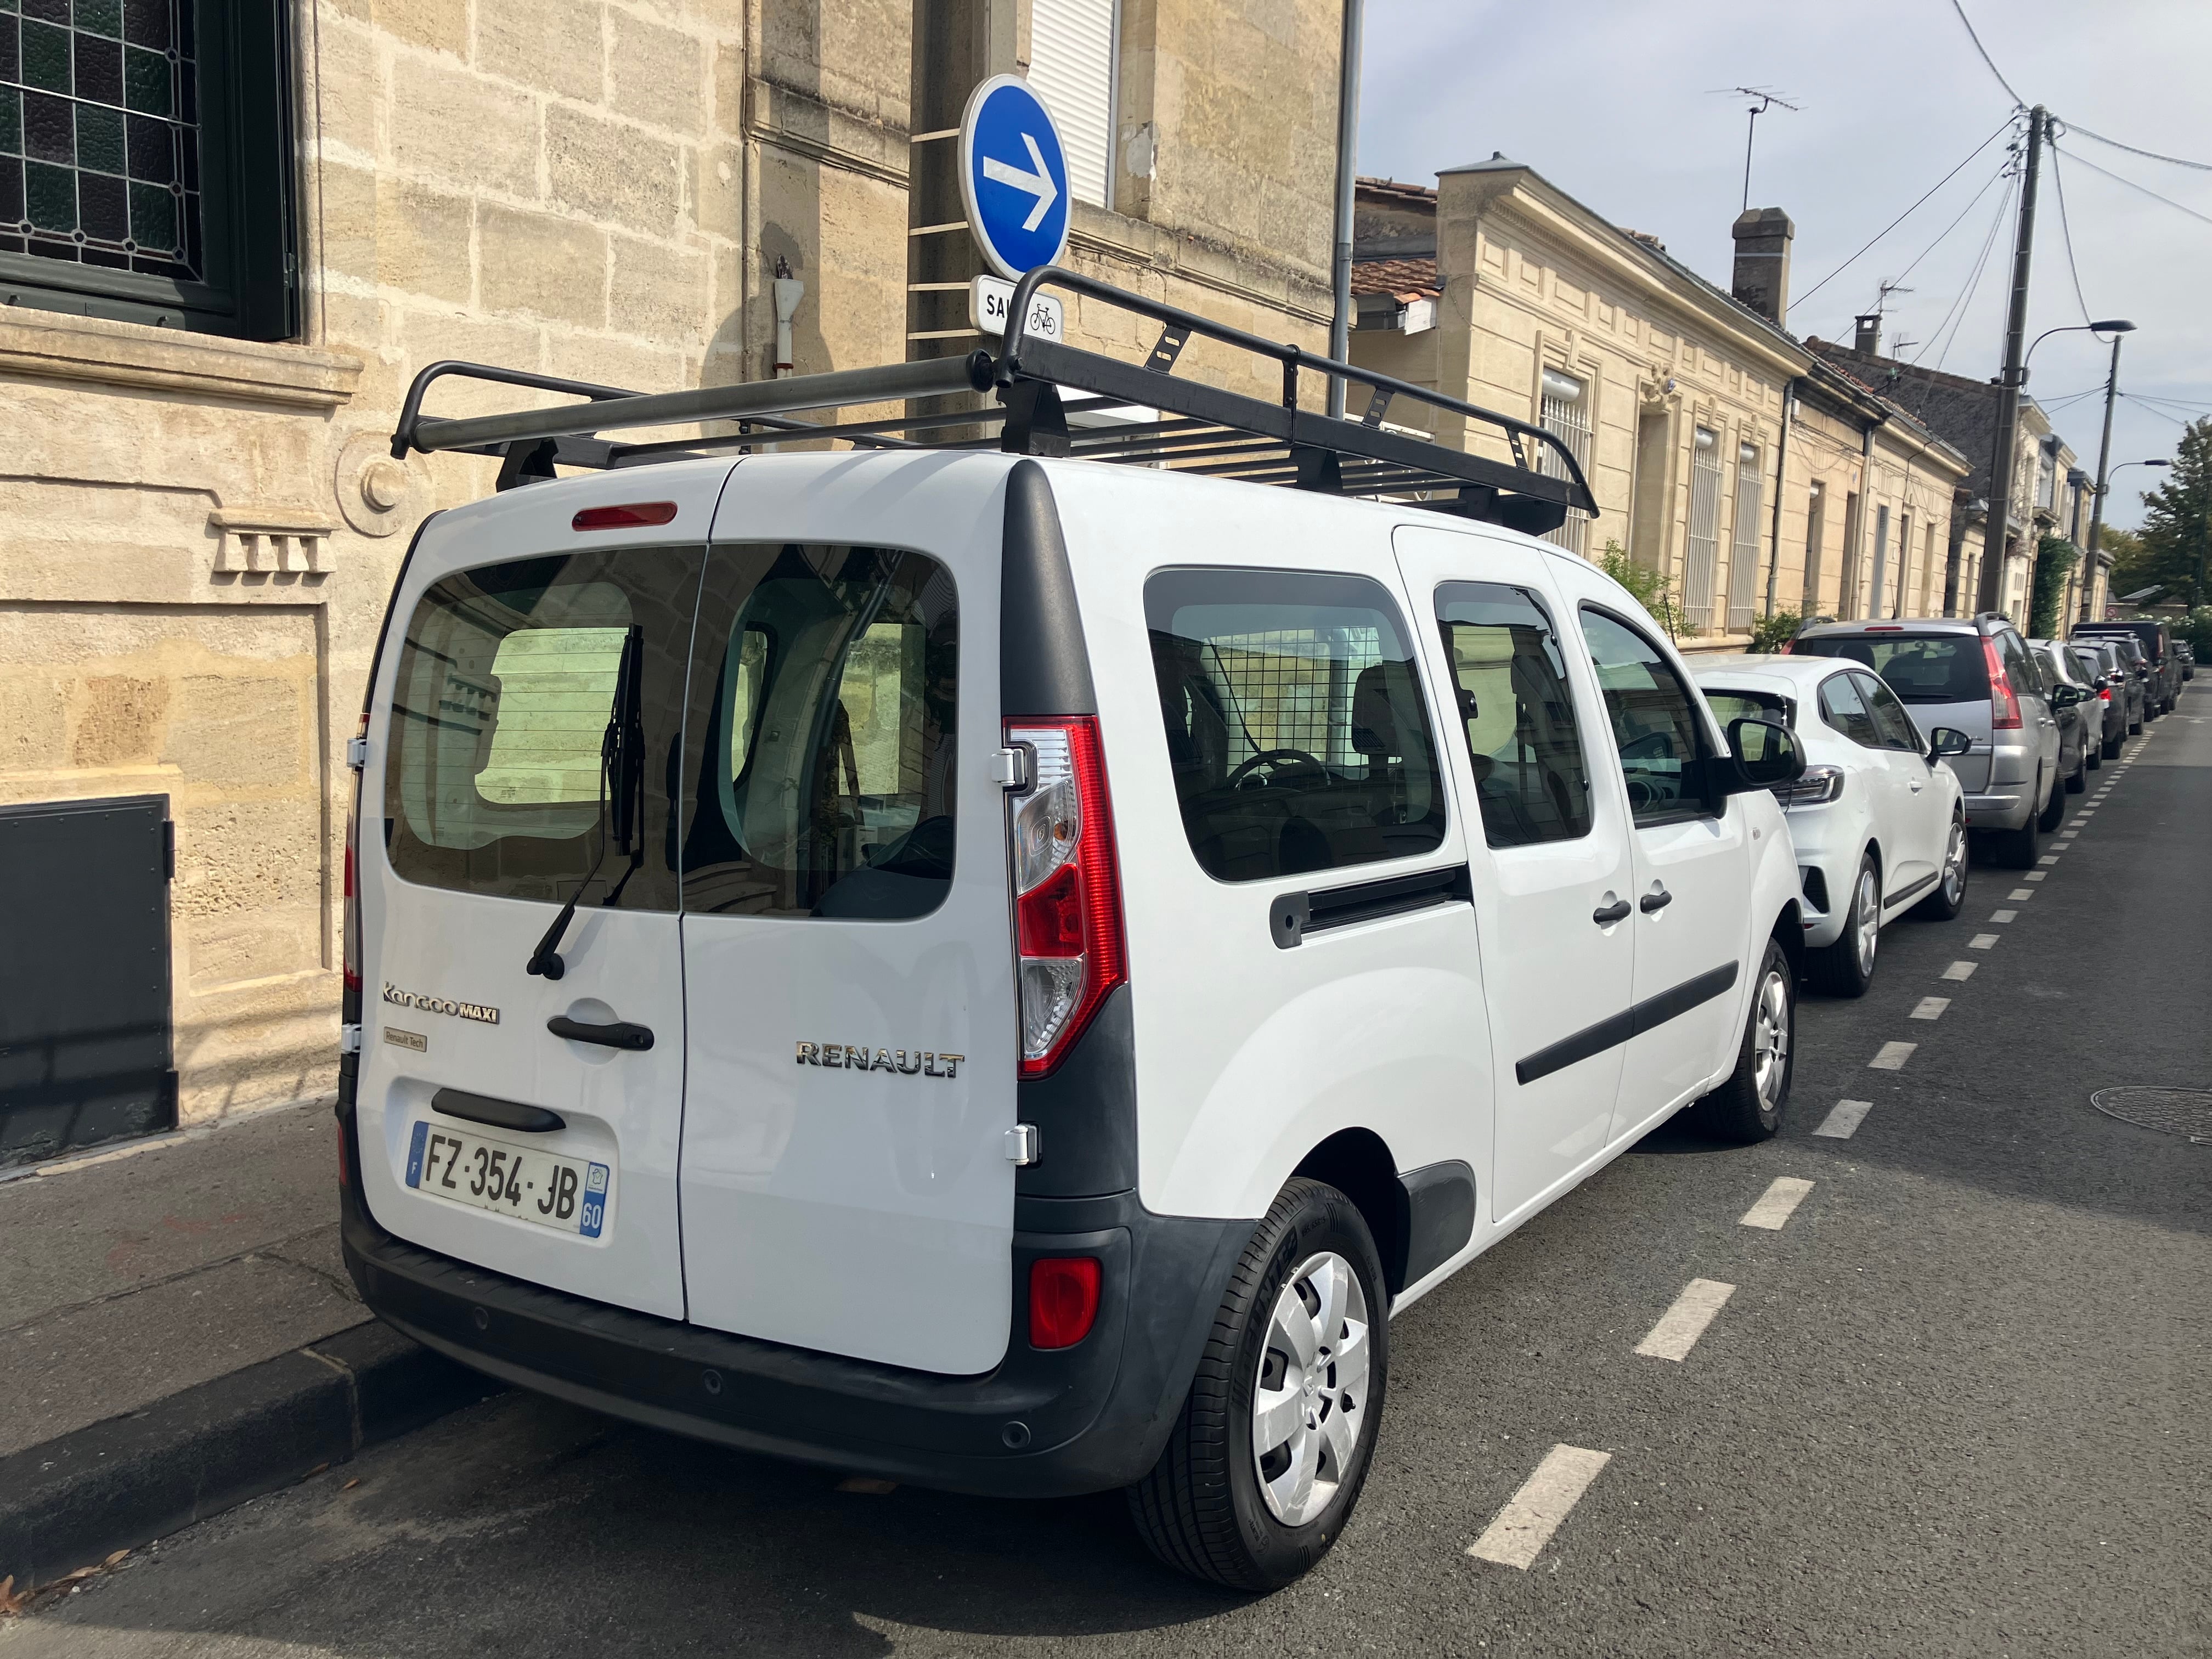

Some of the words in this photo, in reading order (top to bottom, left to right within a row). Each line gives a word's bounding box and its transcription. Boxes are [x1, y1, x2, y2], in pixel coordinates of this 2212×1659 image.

[383, 981, 458, 1016] Kangoo
[460, 1003, 498, 1023] MAXI
[386, 1031, 409, 1045] Renault
[410, 1037, 423, 1048] Tech
[796, 1041, 965, 1079] RENAULT
[411, 1161, 417, 1175] F
[582, 1203, 602, 1229] 60
